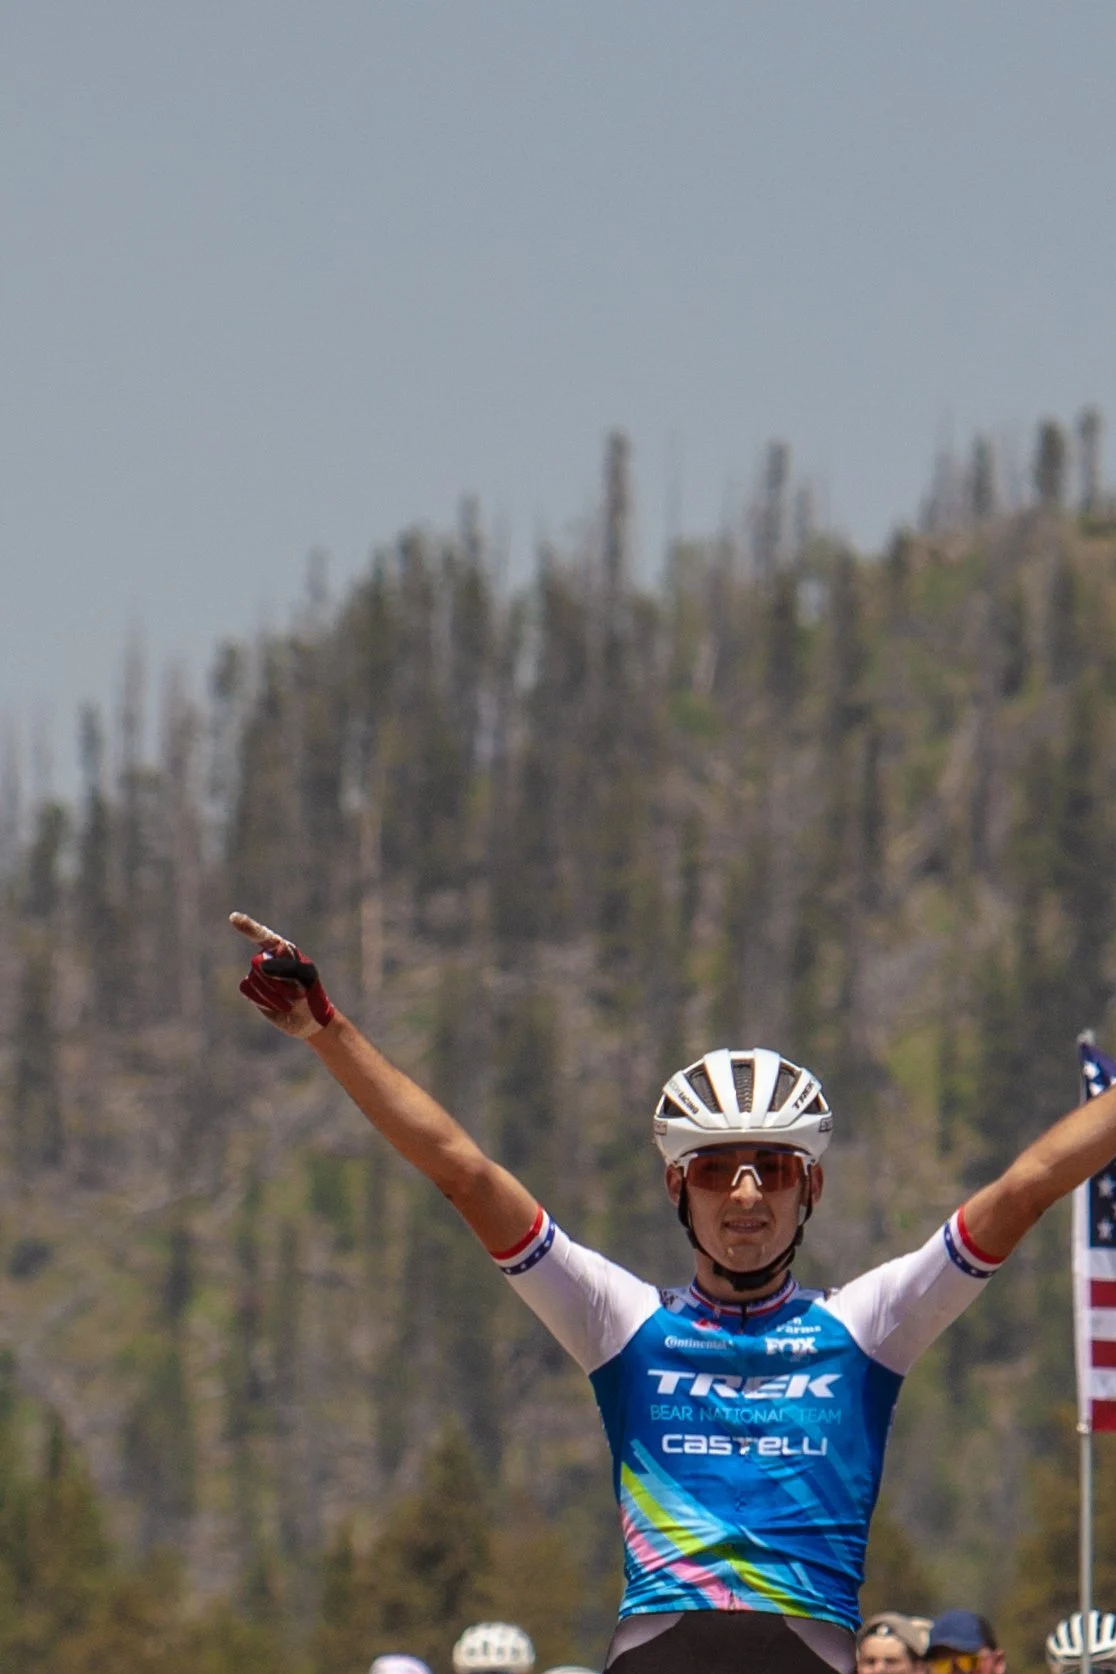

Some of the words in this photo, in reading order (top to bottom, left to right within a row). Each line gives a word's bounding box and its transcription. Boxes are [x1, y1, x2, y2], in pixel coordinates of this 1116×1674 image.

[765, 1337, 818, 1361] FOX
[648, 1369, 844, 1399] TREK
[650, 1404, 693, 1422] BEAR
[701, 1406, 785, 1425] NATIONAL
[798, 1408, 842, 1425] TEAM
